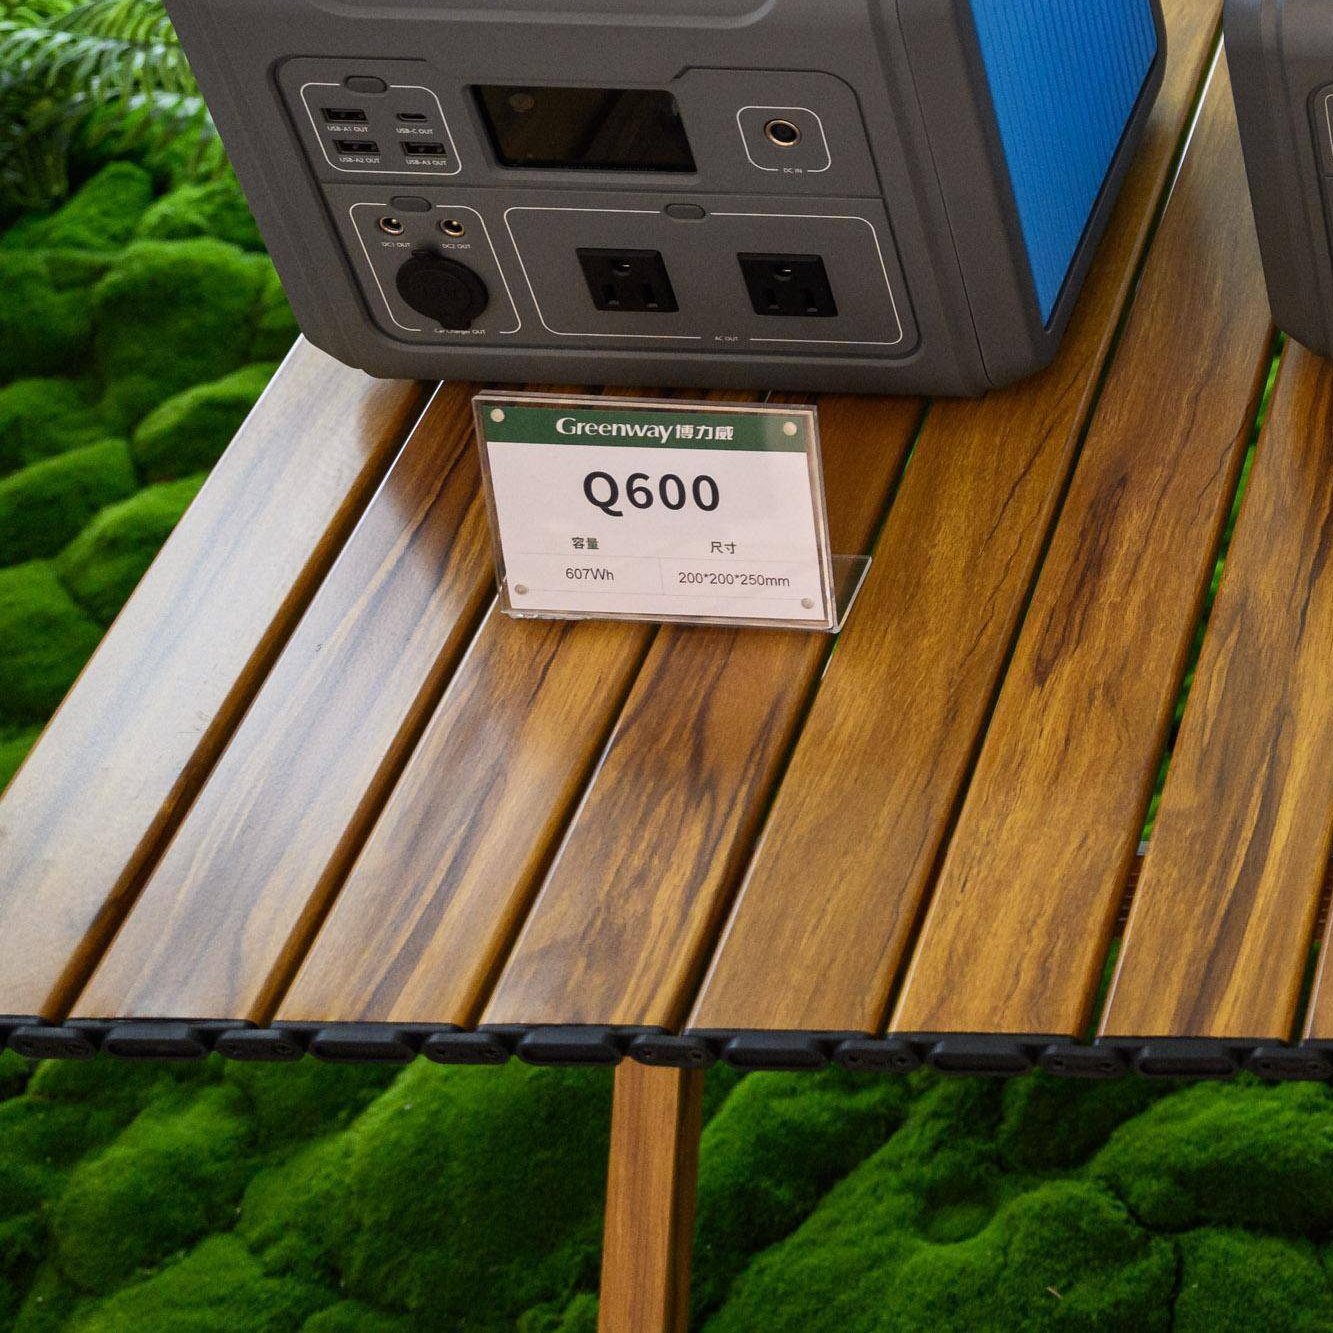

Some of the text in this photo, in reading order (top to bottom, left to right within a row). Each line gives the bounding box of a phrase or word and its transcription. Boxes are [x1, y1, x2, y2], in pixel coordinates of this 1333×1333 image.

[555, 416, 673, 444] Greenway
[675, 424, 734, 441] 博力威
[583, 470, 721, 517] Q600
[571, 535, 600, 551] 容量
[709, 540, 737, 555] 尺寸
[565, 567, 614, 582] 607Wh
